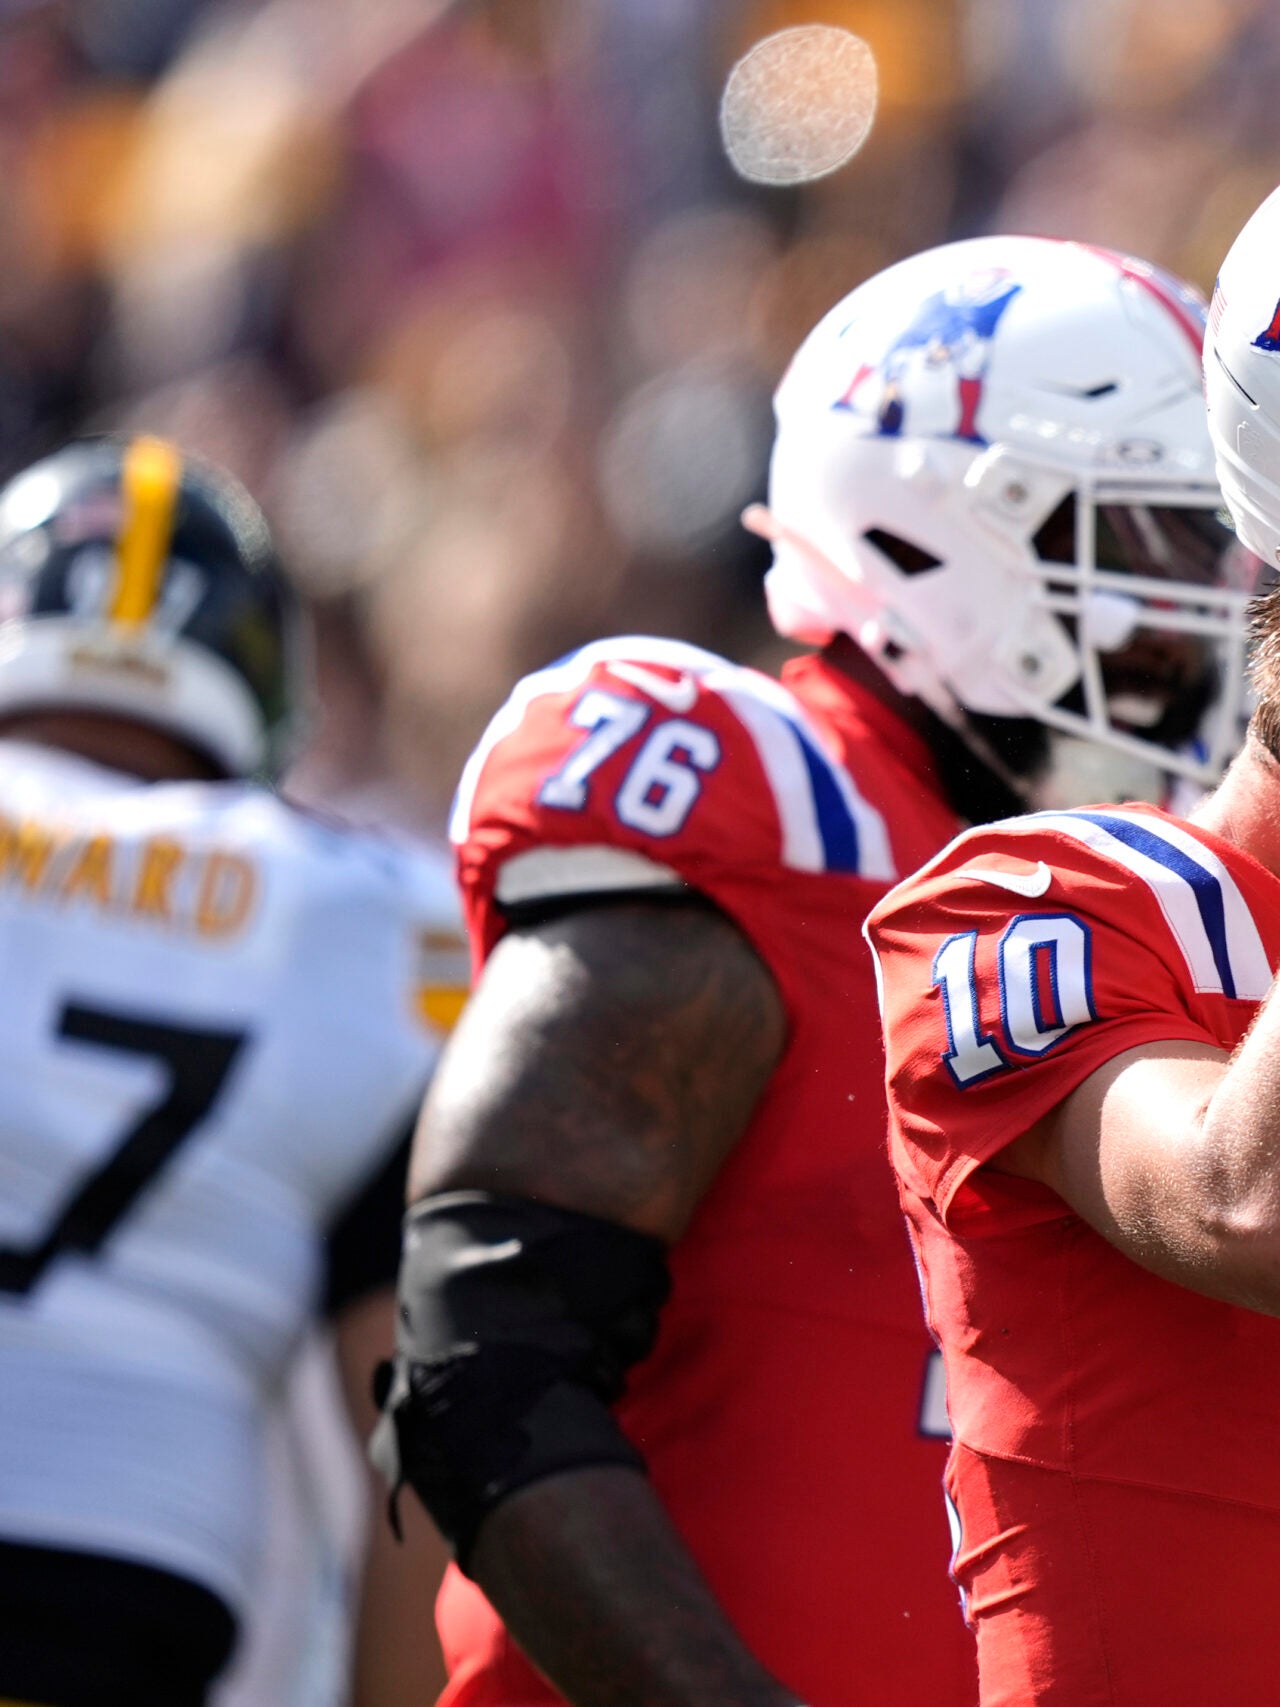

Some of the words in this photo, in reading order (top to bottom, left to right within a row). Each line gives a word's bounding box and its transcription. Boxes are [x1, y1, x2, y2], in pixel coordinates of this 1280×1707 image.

[534, 688, 722, 839] 76
[932, 911, 1098, 1091] 10
[0, 1000, 250, 1297] 7
